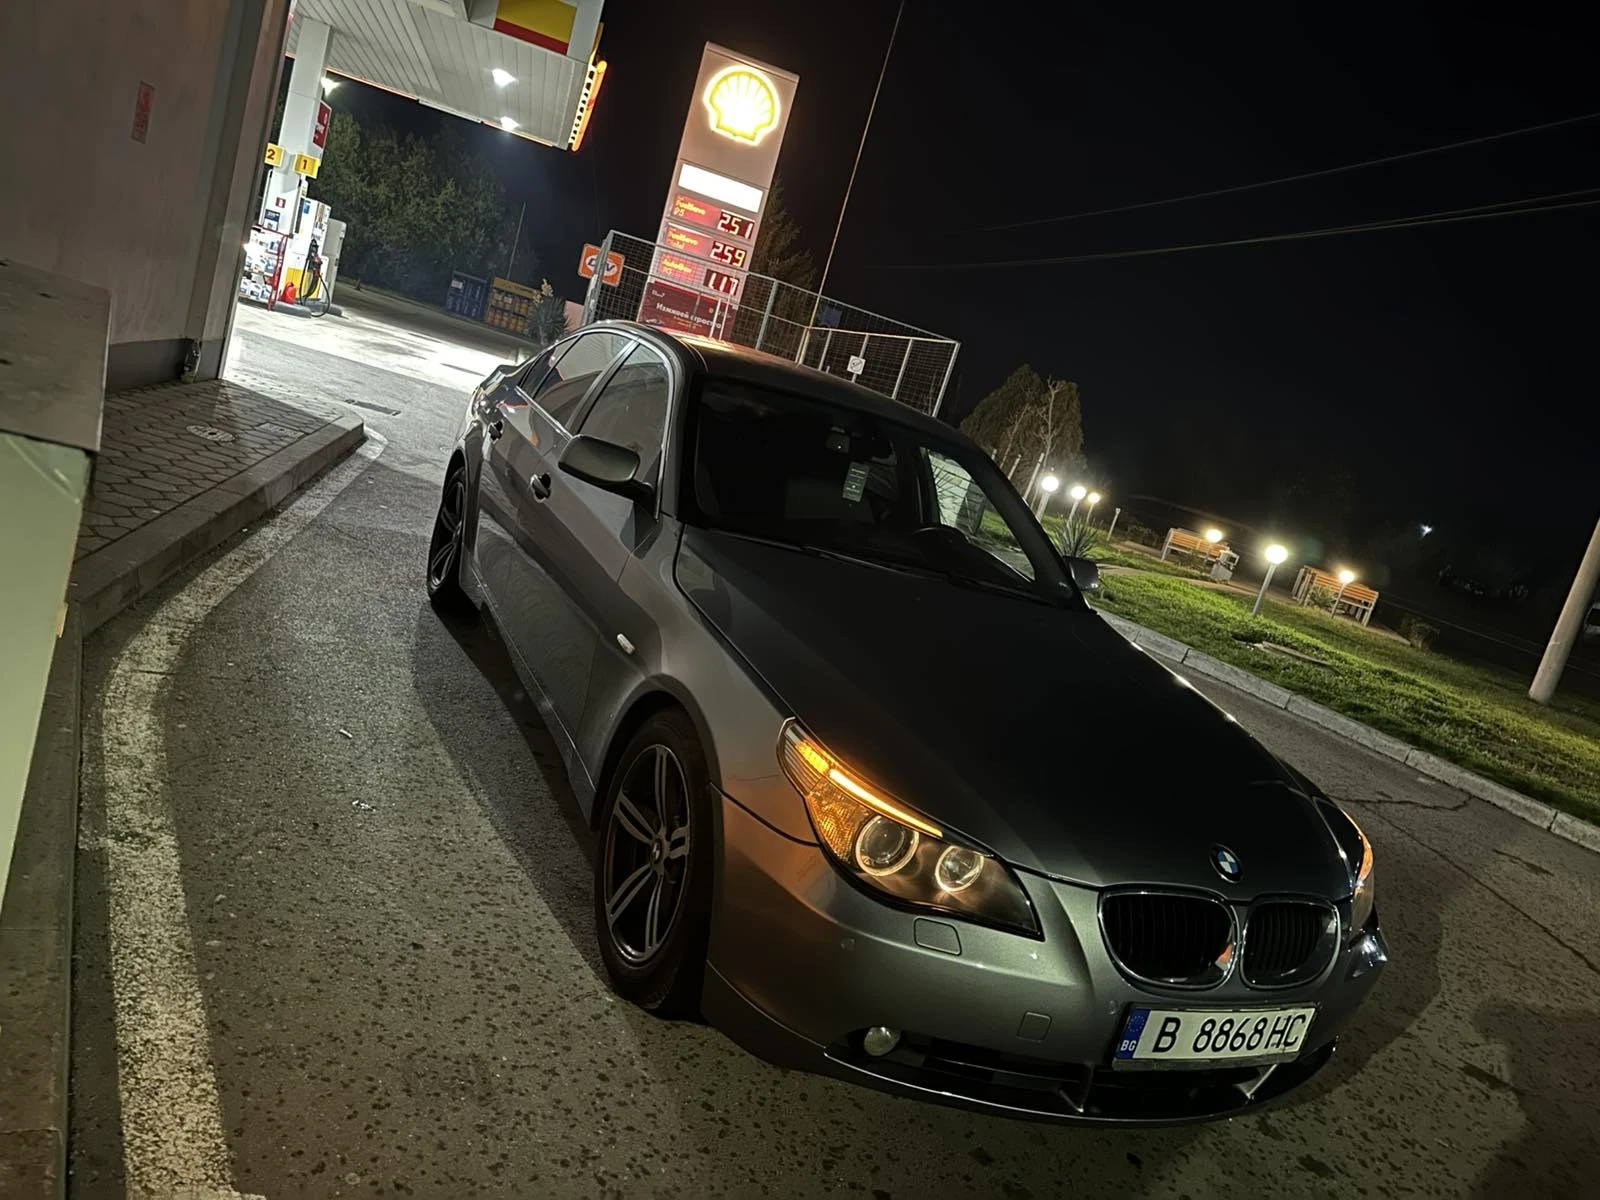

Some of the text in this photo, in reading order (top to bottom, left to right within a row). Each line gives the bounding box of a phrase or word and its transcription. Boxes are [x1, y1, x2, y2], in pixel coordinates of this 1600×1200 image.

[266, 148, 276, 160] 2
[301, 159, 308, 170] 1
[1152, 1016, 1182, 1053] B
[1120, 1039, 1137, 1052] BG
